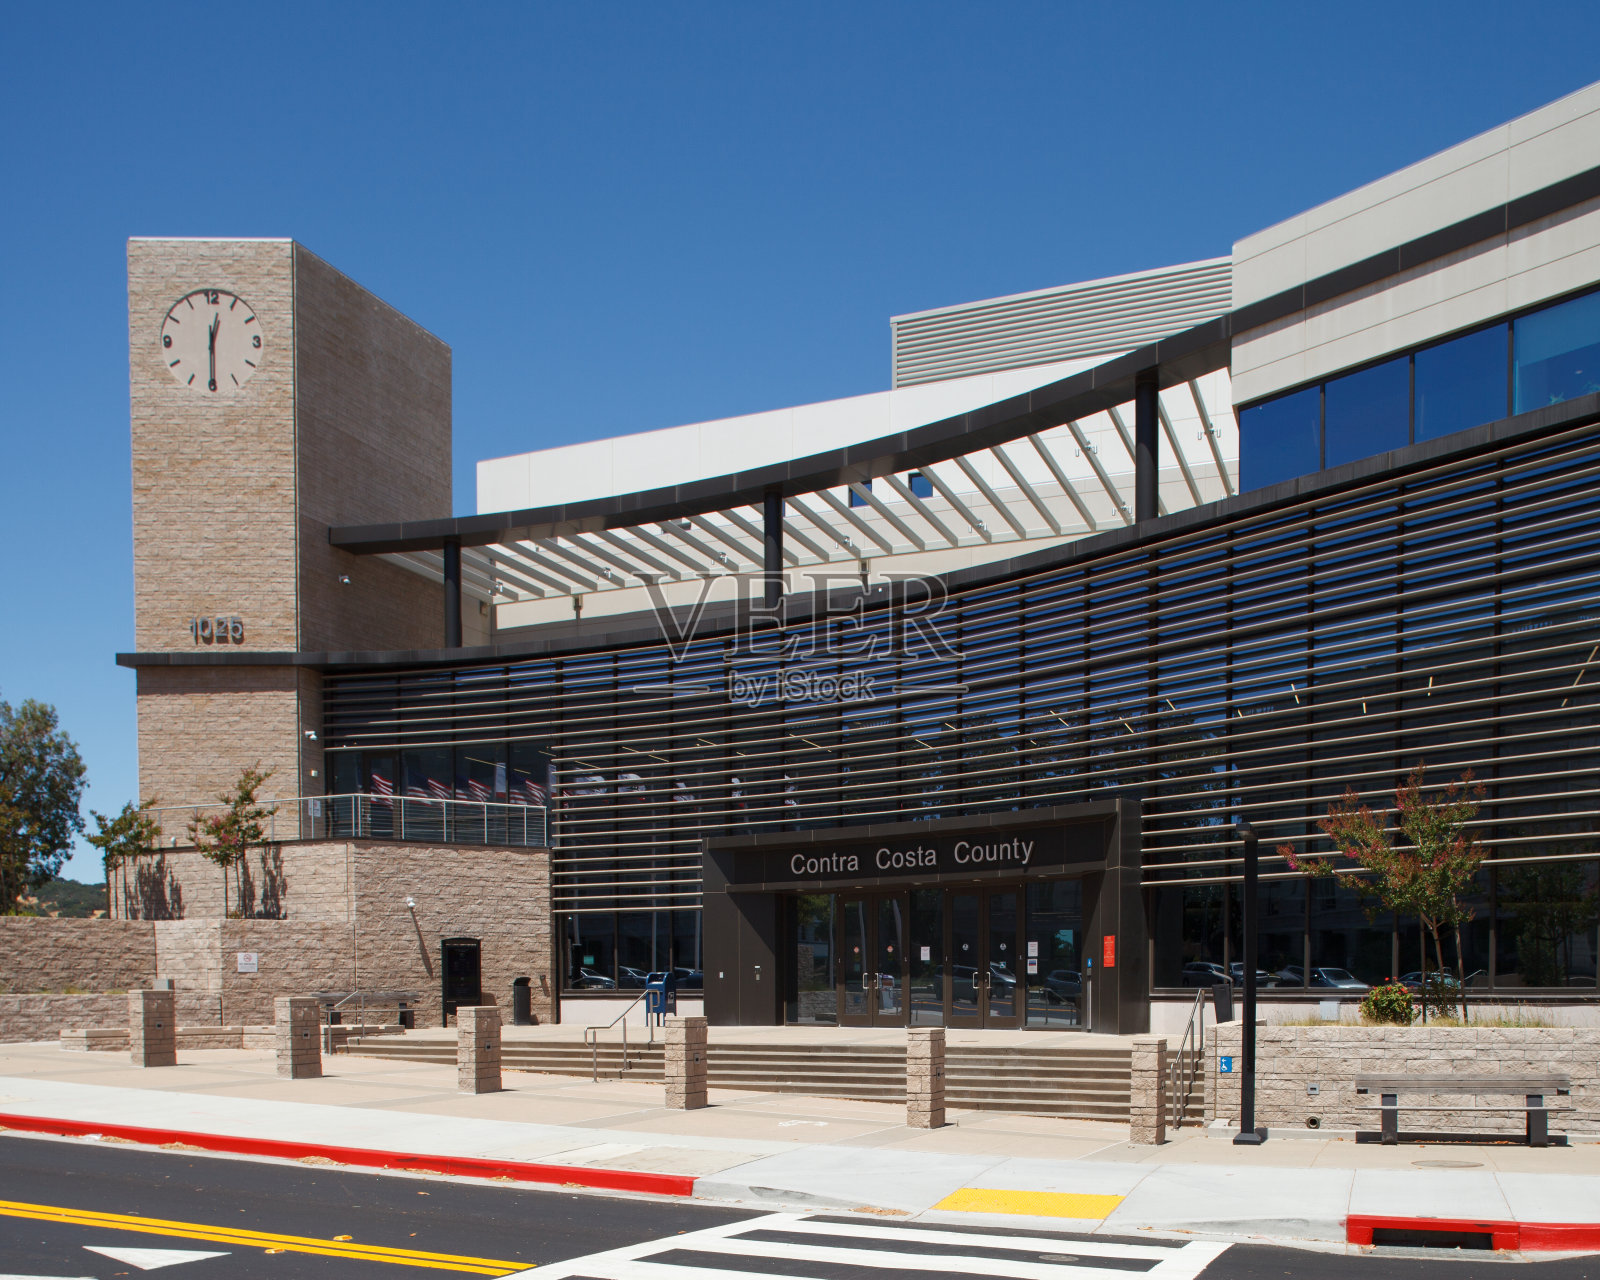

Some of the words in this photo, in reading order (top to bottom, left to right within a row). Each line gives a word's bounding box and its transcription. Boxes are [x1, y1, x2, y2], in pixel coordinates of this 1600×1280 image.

[205, 291, 219, 304] 12
[163, 335, 172, 348] 9
[252, 335, 261, 348] 3
[189, 616, 243, 637] 1025
[790, 852, 859, 875] Contra
[876, 846, 937, 869] Costa
[954, 837, 1034, 865] County
